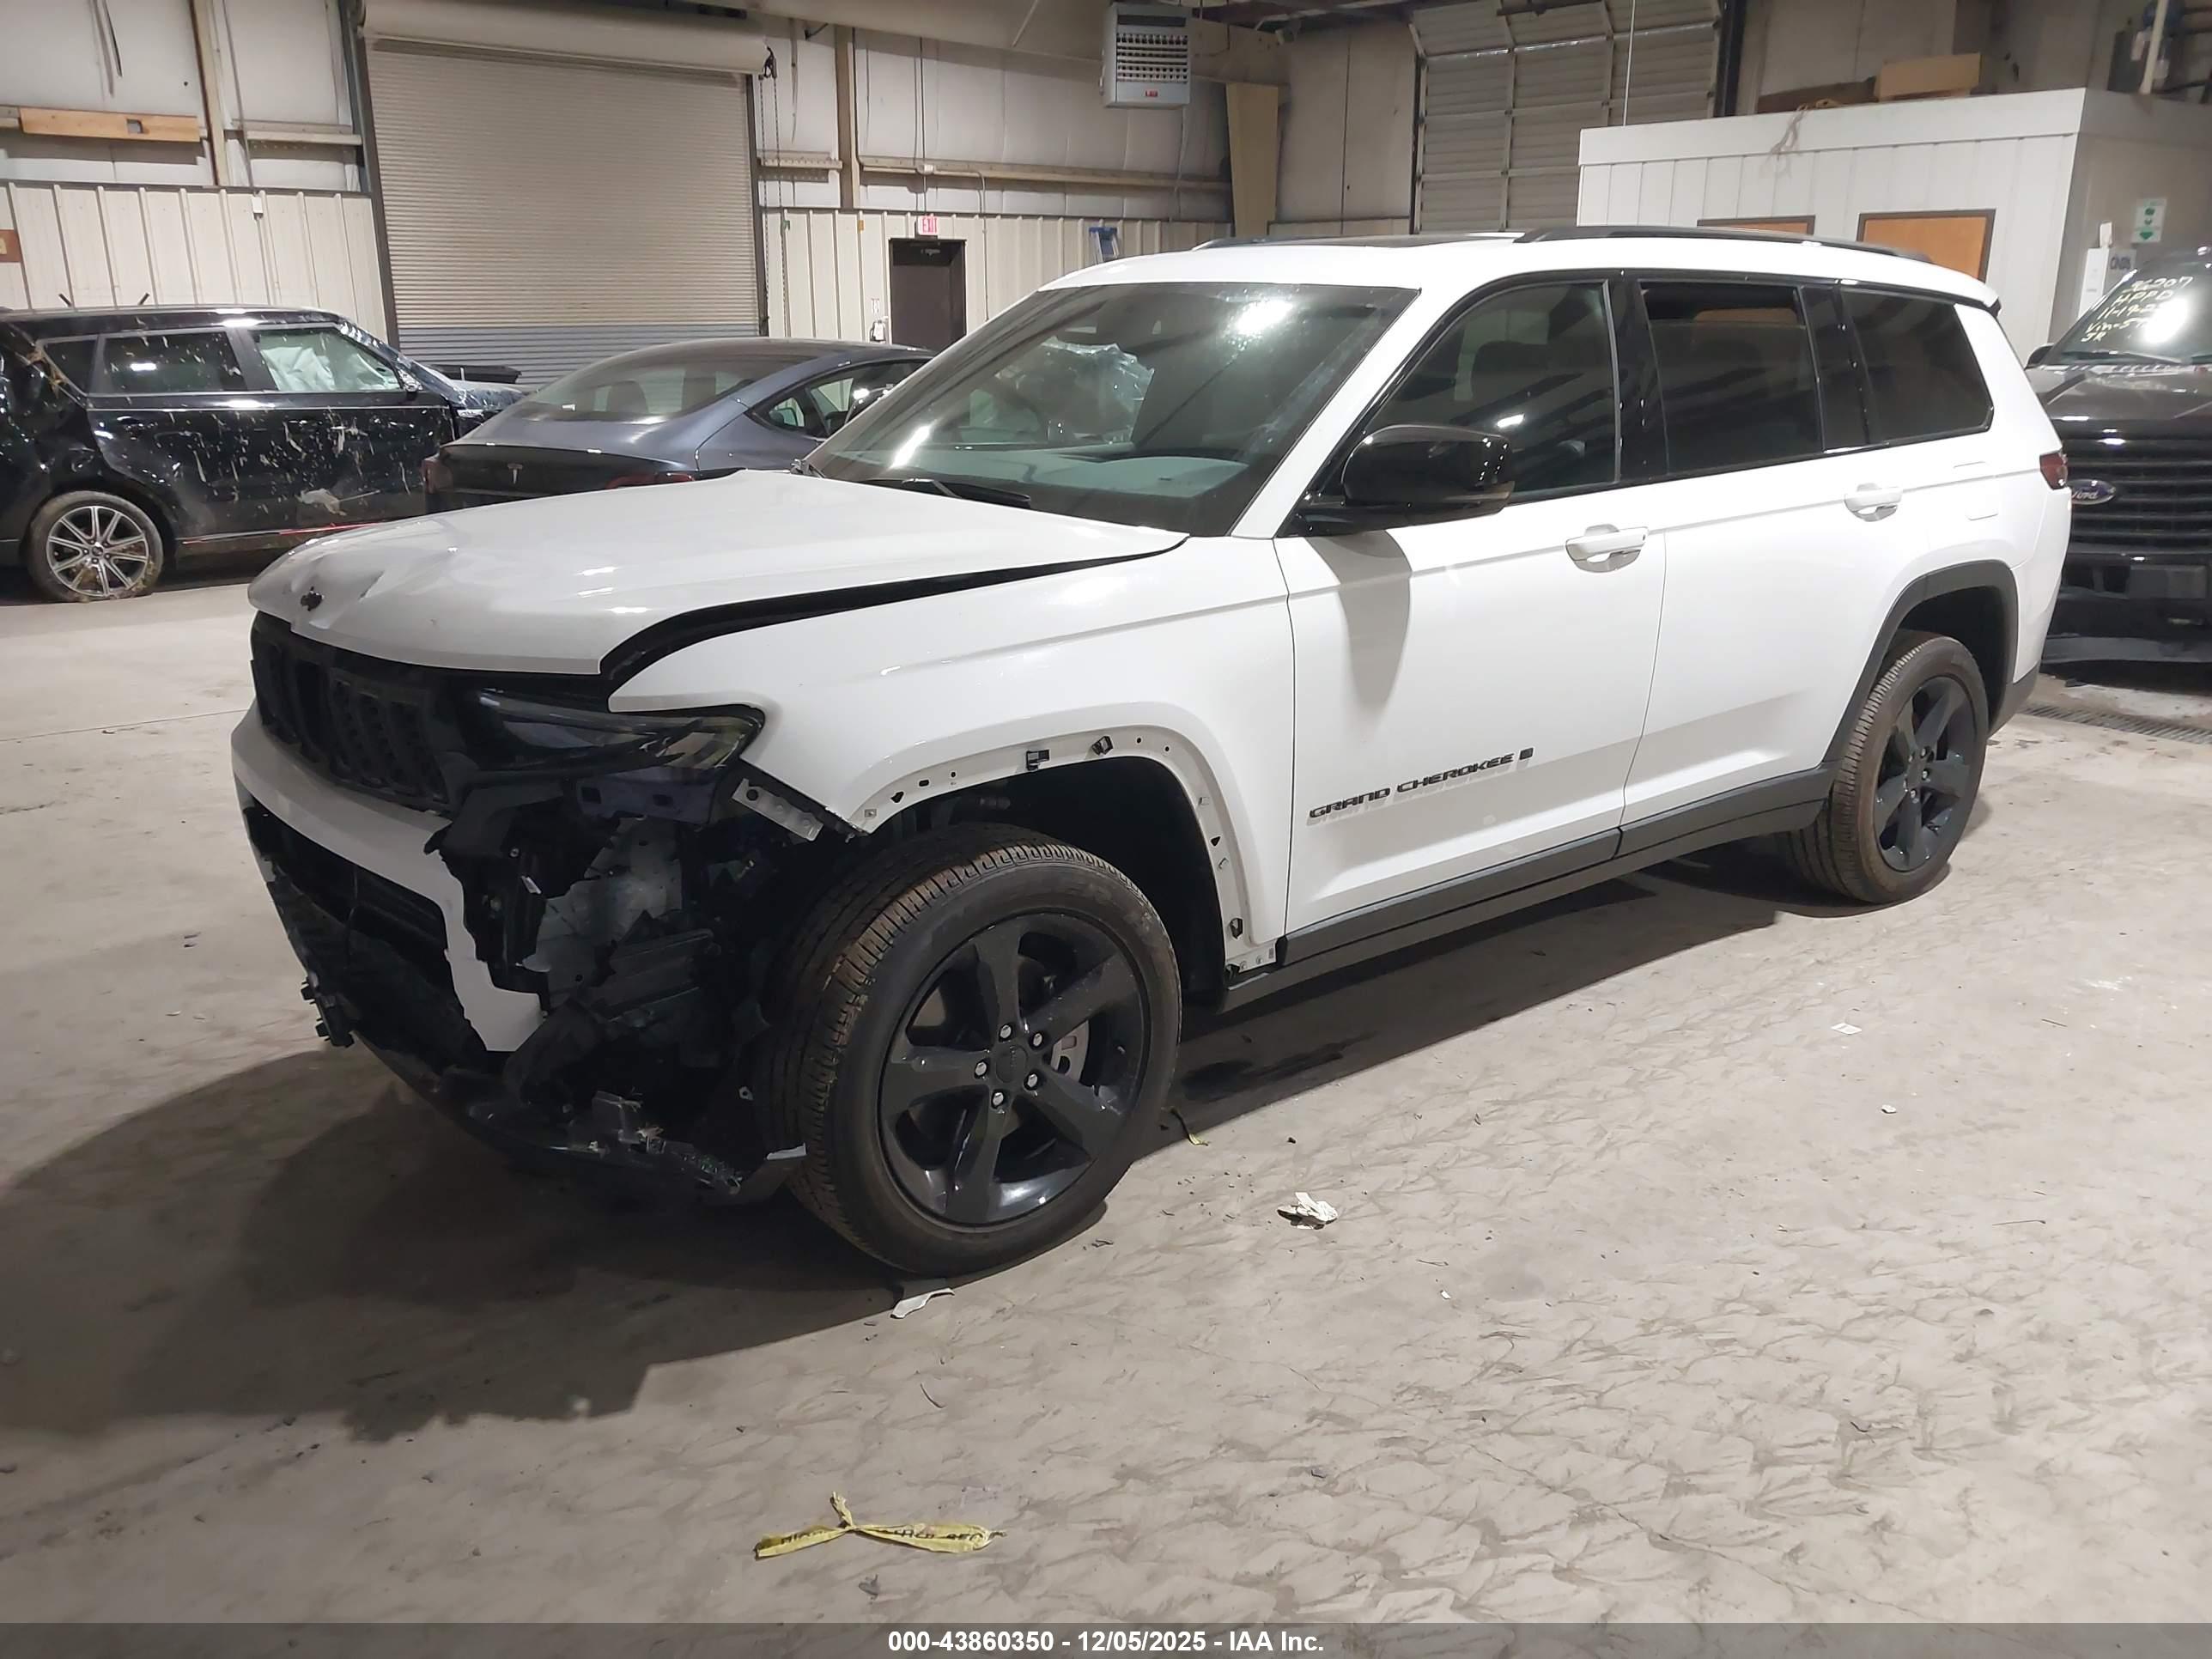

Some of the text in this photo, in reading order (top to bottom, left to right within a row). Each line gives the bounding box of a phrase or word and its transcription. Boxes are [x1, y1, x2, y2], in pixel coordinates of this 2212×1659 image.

[922, 216, 937, 233] EXIT
[1309, 752, 1515, 818] GRAND CHEROKEE
